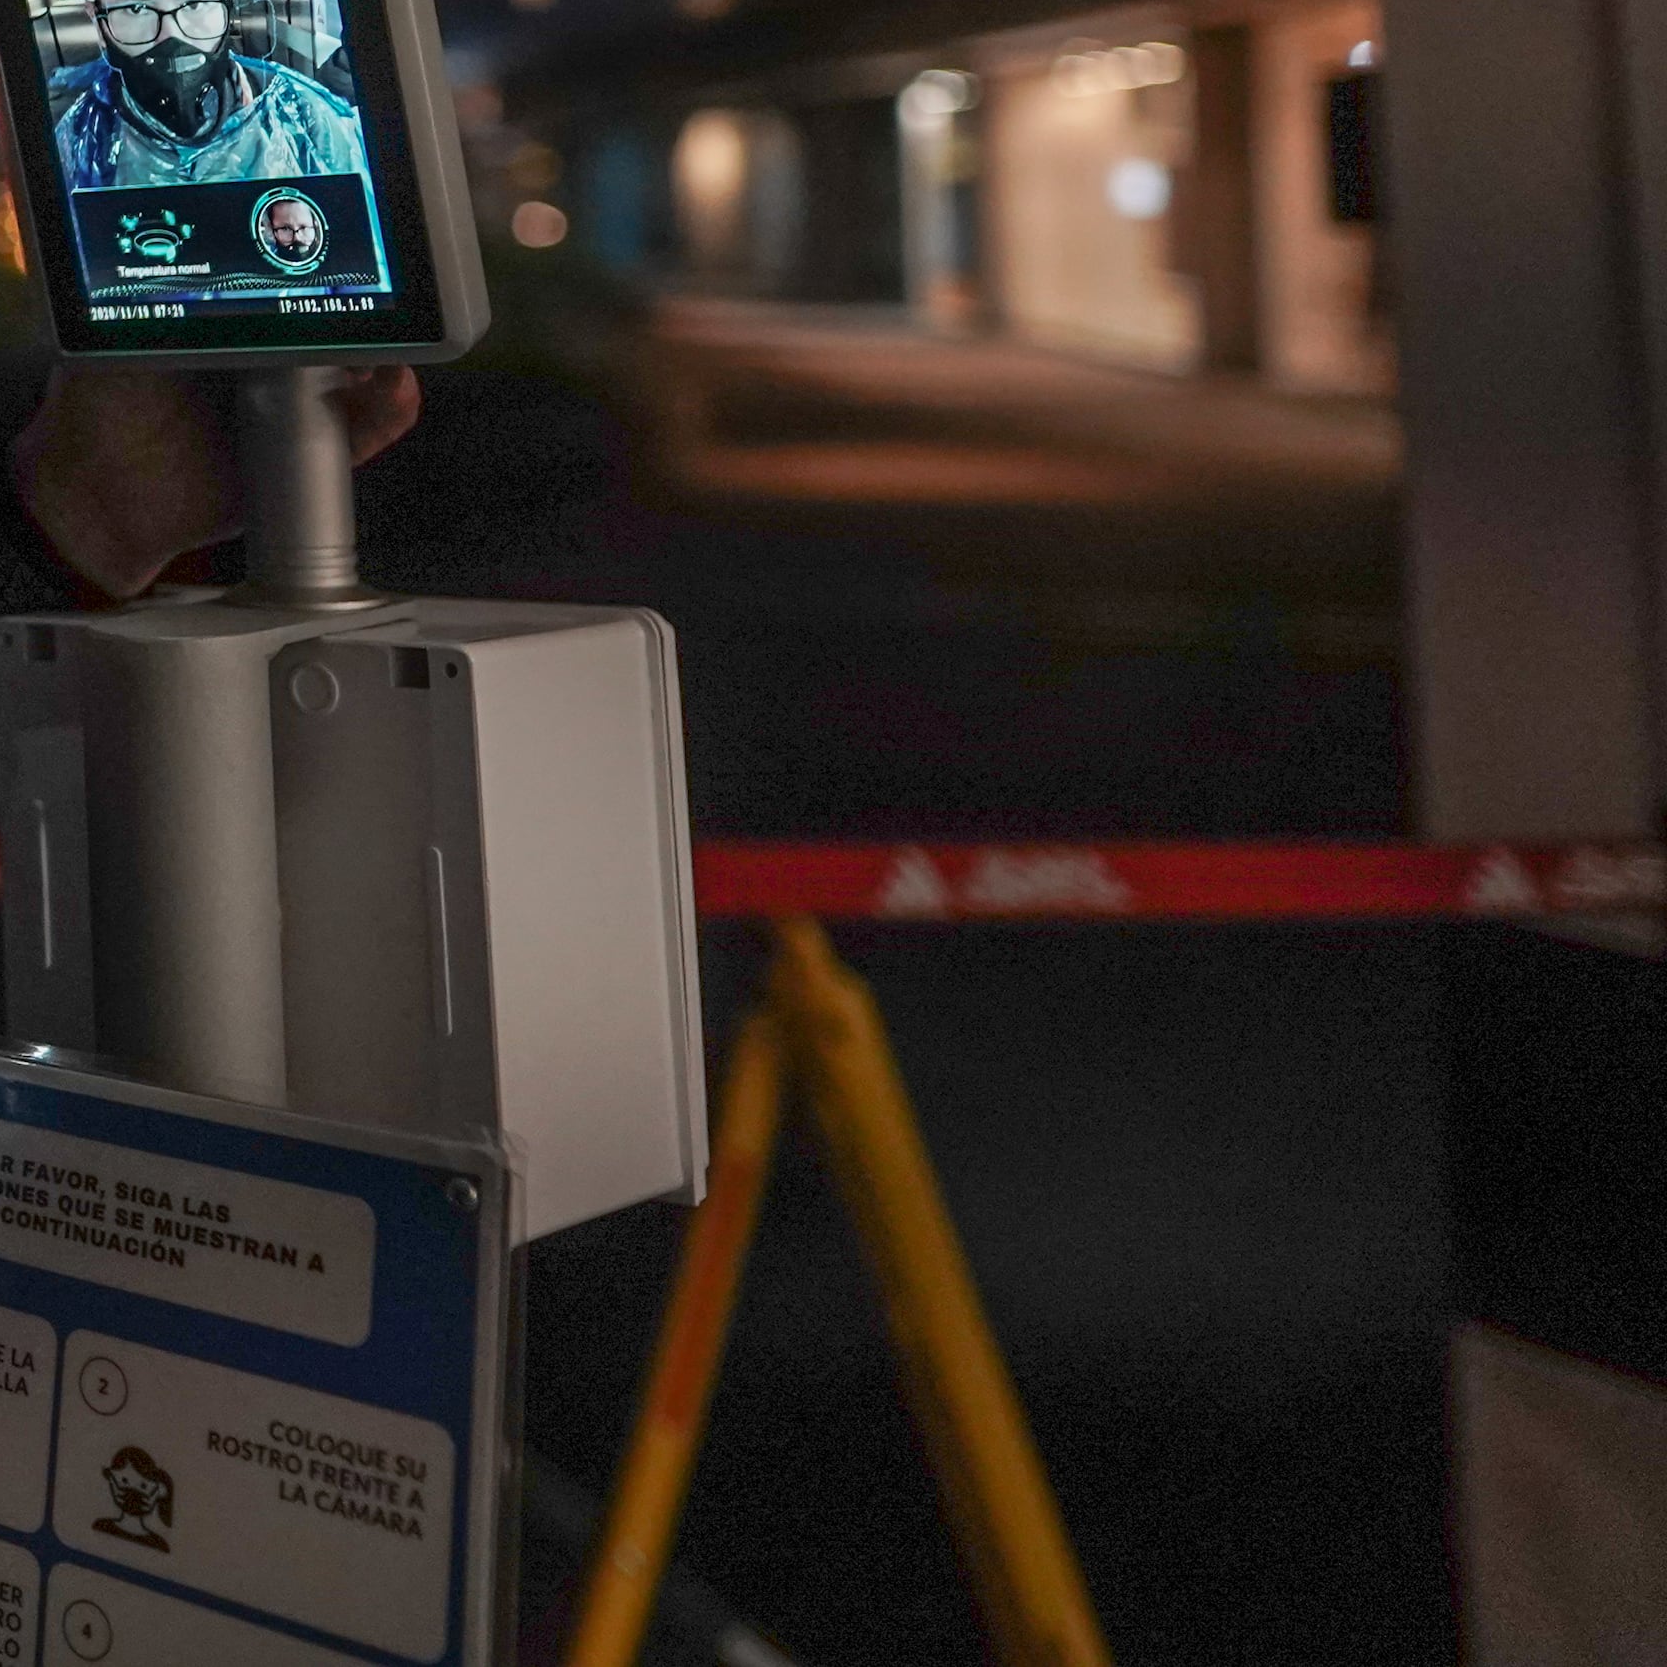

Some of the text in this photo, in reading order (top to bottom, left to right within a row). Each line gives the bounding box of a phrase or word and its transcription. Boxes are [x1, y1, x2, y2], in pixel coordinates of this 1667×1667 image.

[178, 262, 211, 275] normal
[22, 1160, 105, 1199] FAVOR,
[115, 1181, 173, 1211] SIGA
[183, 1197, 231, 1223] LAS
[0, 1206, 186, 1268] CONTINUACIÓN
[57, 1194, 106, 1222] QUE
[114, 1208, 145, 1231] SE
[153, 1216, 299, 1268] MUESTRAN
[307, 1253, 325, 1274] A
[11, 1347, 35, 1373] LA
[98, 1377, 109, 1395] 2
[207, 1430, 425, 1512] ROSTRO FRENTE A
[268, 1419, 427, 1482] COLOQUE SU
[278, 1479, 308, 1507] LA
[81, 1622, 93, 1639] 4
